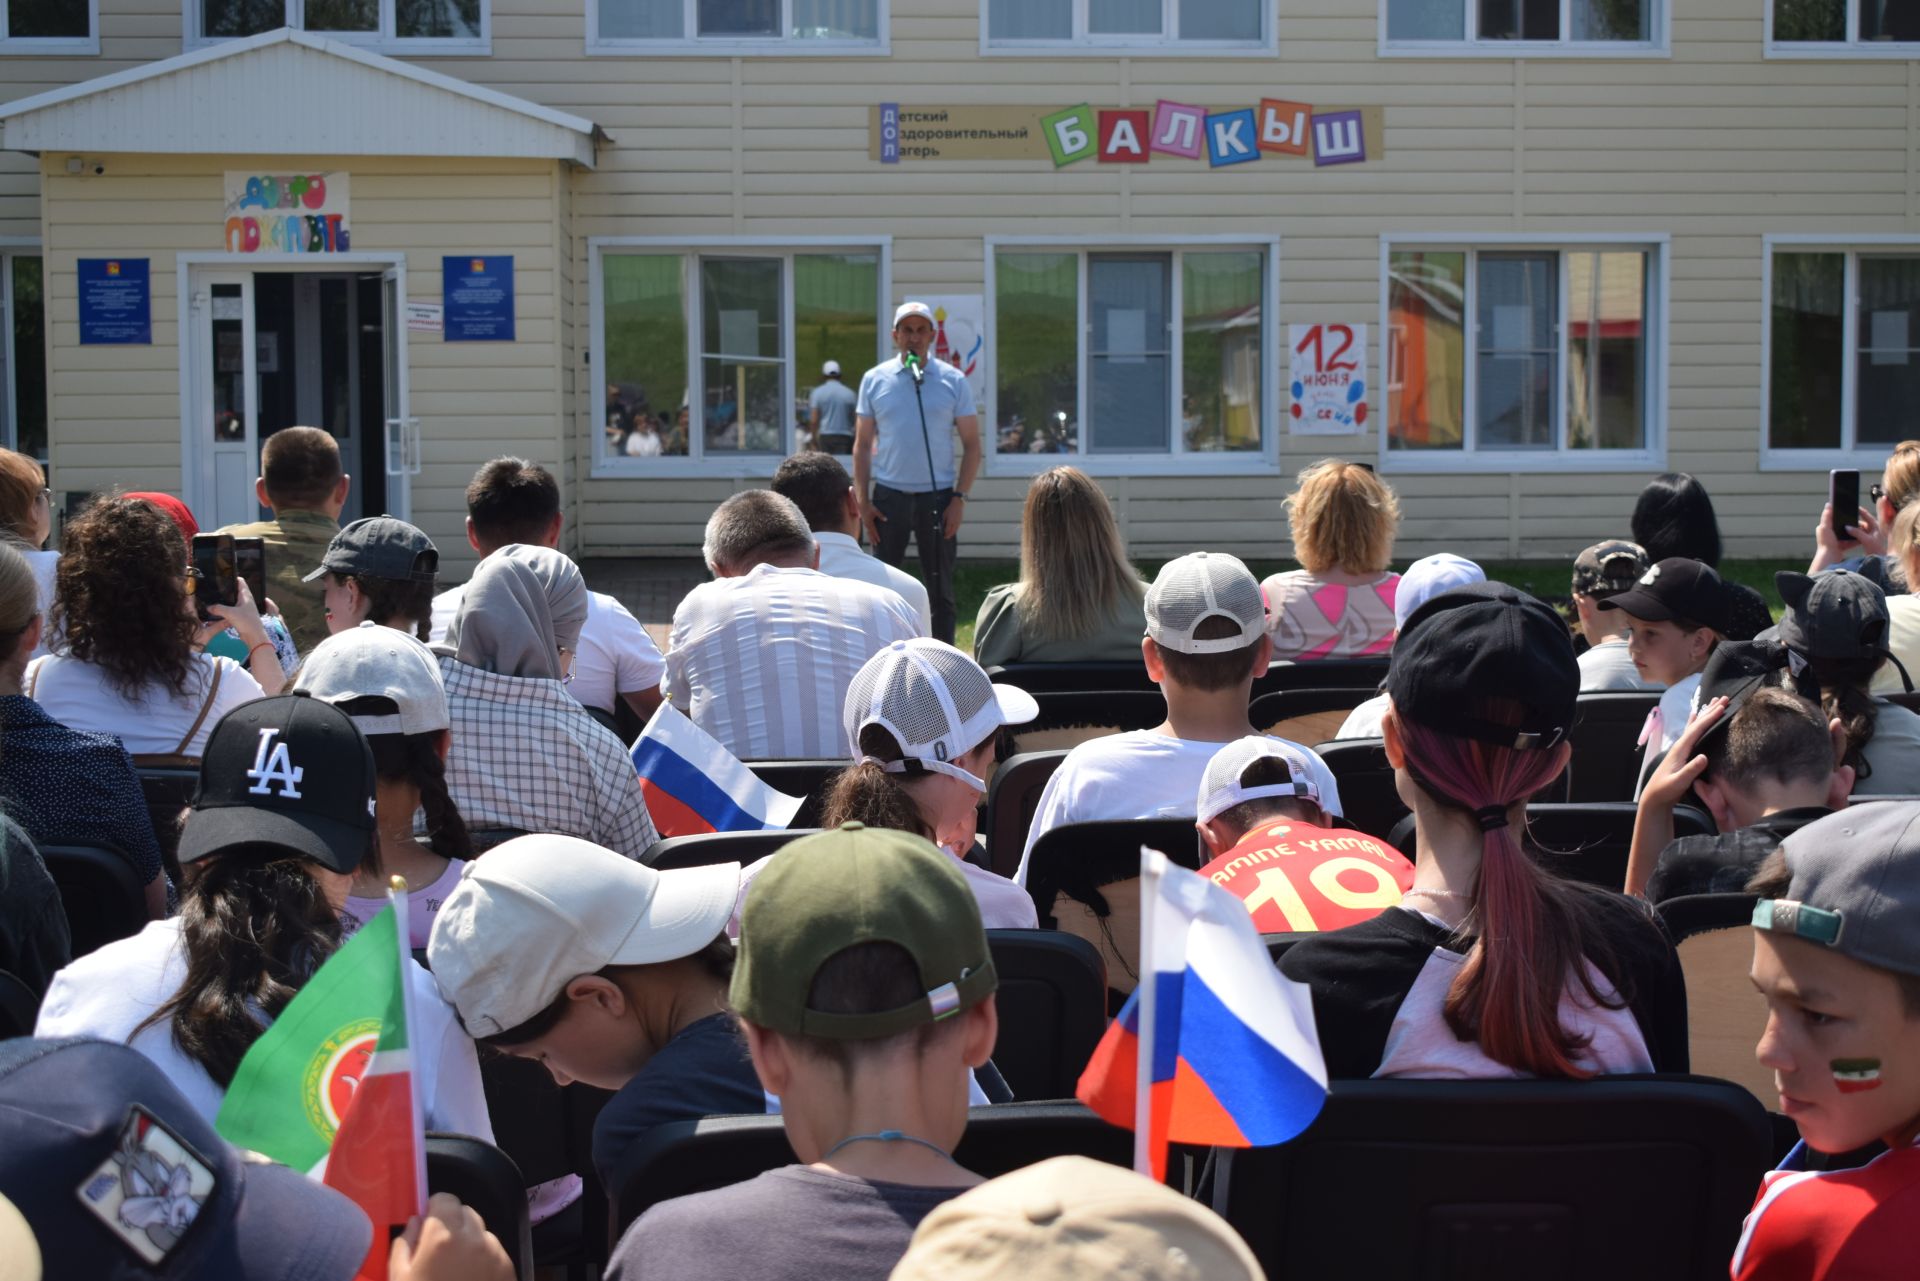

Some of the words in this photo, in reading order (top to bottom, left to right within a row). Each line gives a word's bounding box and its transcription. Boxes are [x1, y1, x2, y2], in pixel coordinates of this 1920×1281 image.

[1054, 108, 1360, 158] БАЛКЫШ
[240, 175, 326, 210] ДОБРО
[225, 214, 350, 253] ПОЖАЛОВАТЬ
[1296, 324, 1358, 373] 12
[247, 728, 304, 798] LA
[1209, 842, 1297, 888] AMINE
[1298, 836, 1394, 863] YAMAL
